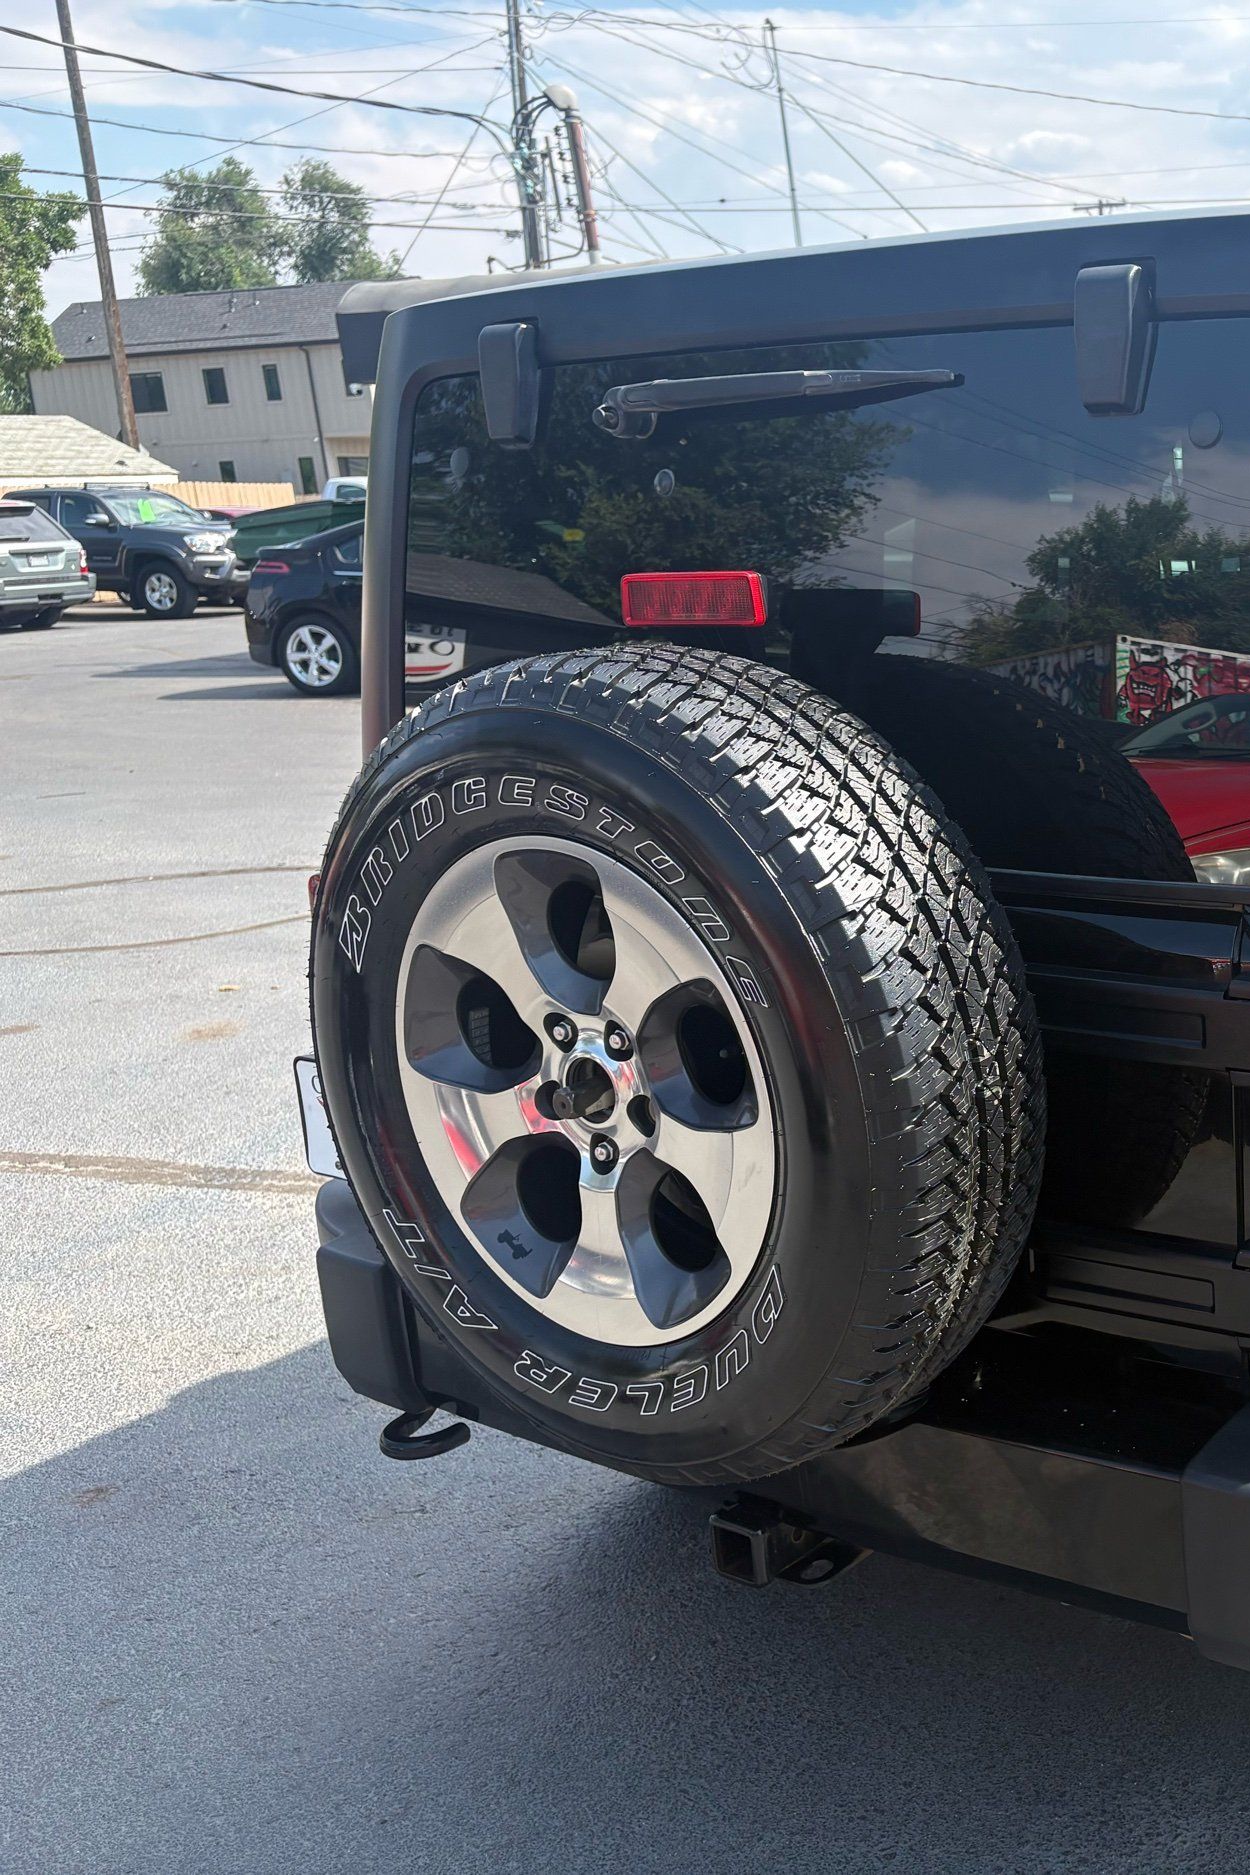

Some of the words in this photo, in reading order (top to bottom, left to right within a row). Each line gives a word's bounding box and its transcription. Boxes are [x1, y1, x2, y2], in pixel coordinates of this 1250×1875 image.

[339, 775, 770, 1009] BRIDGESTONE
[382, 1208, 499, 1330] A/T
[513, 1263, 786, 1416] DUELER
